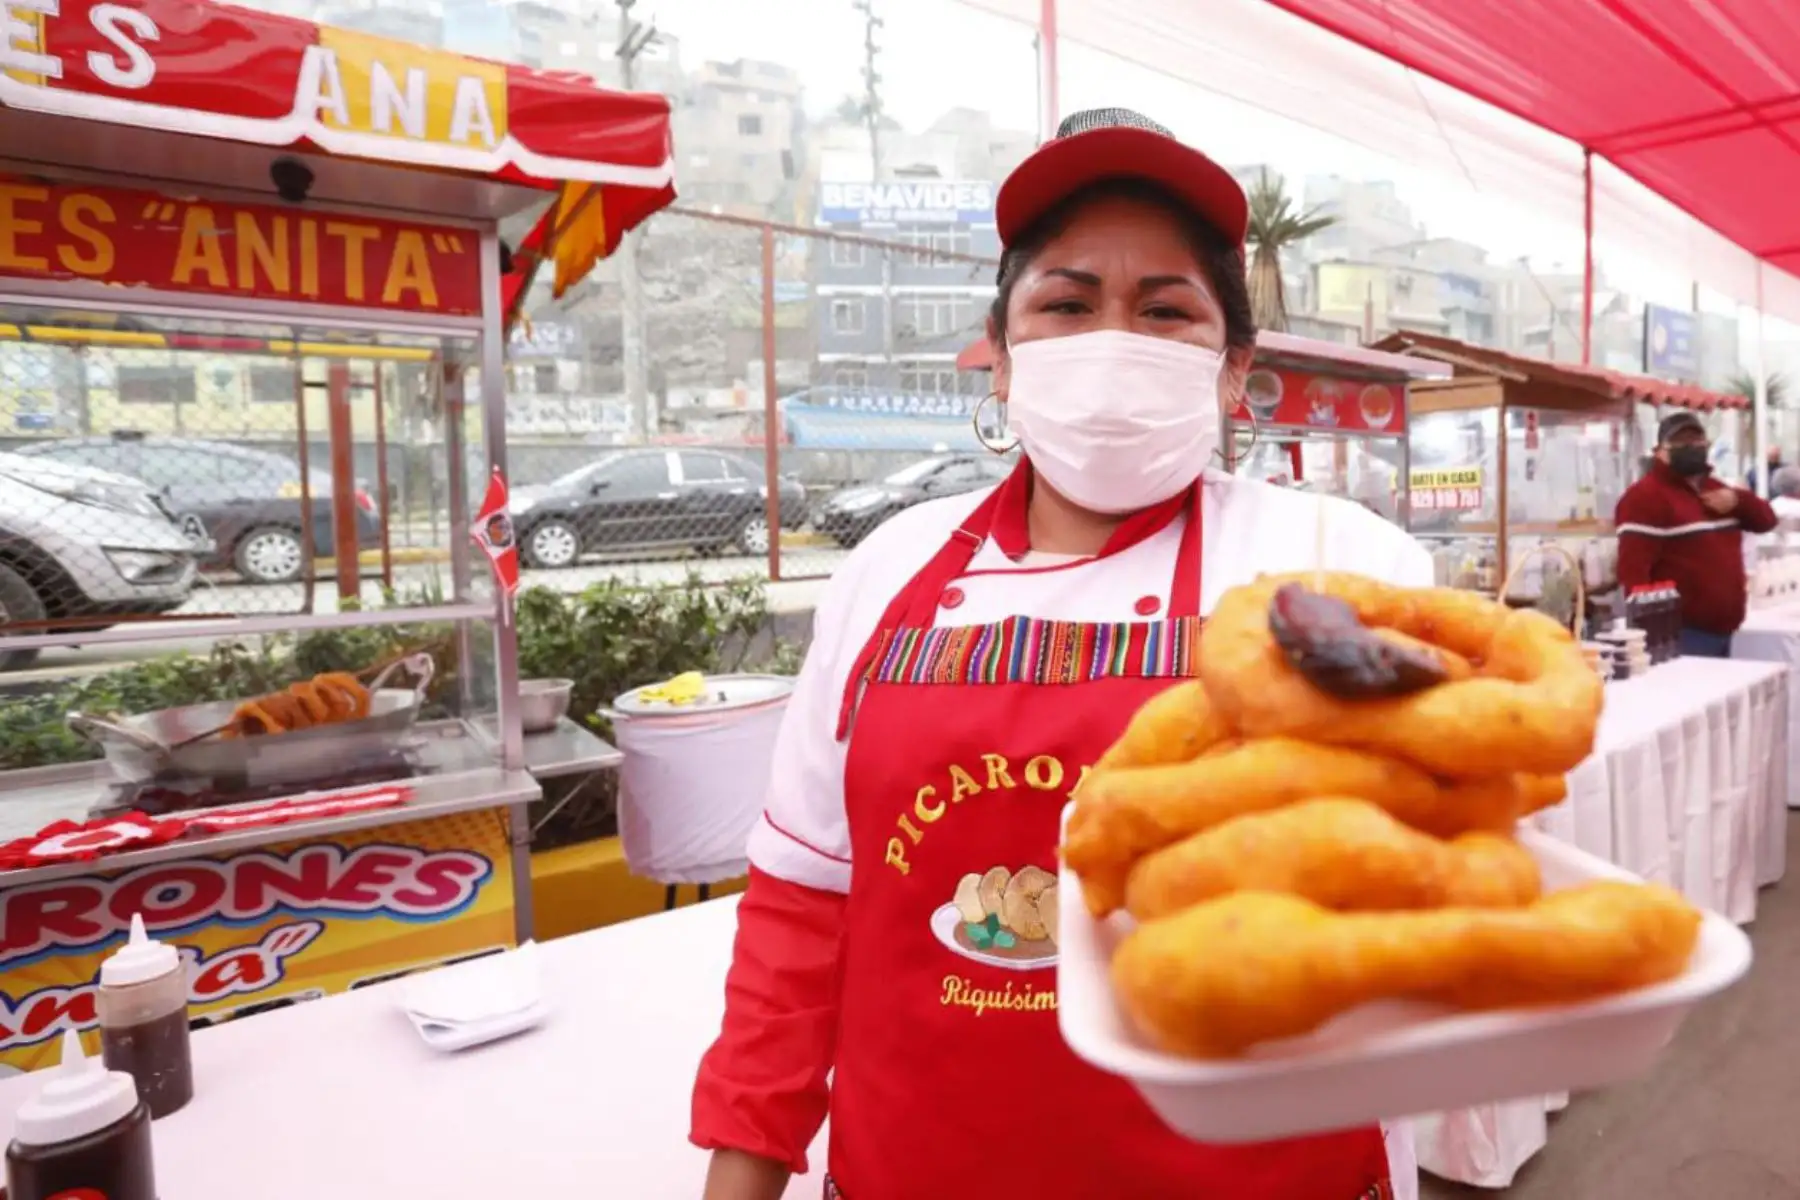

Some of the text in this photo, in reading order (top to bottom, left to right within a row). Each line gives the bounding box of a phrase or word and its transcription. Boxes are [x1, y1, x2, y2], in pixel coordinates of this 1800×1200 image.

[0, 0, 495, 145] ES ANA
[0, 183, 117, 276] ES
[822, 182, 992, 211] BENAVIDES
[1450, 471, 1477, 484] CASA
[0, 853, 477, 952] RONES
[940, 975, 1058, 1016] Riquísim
